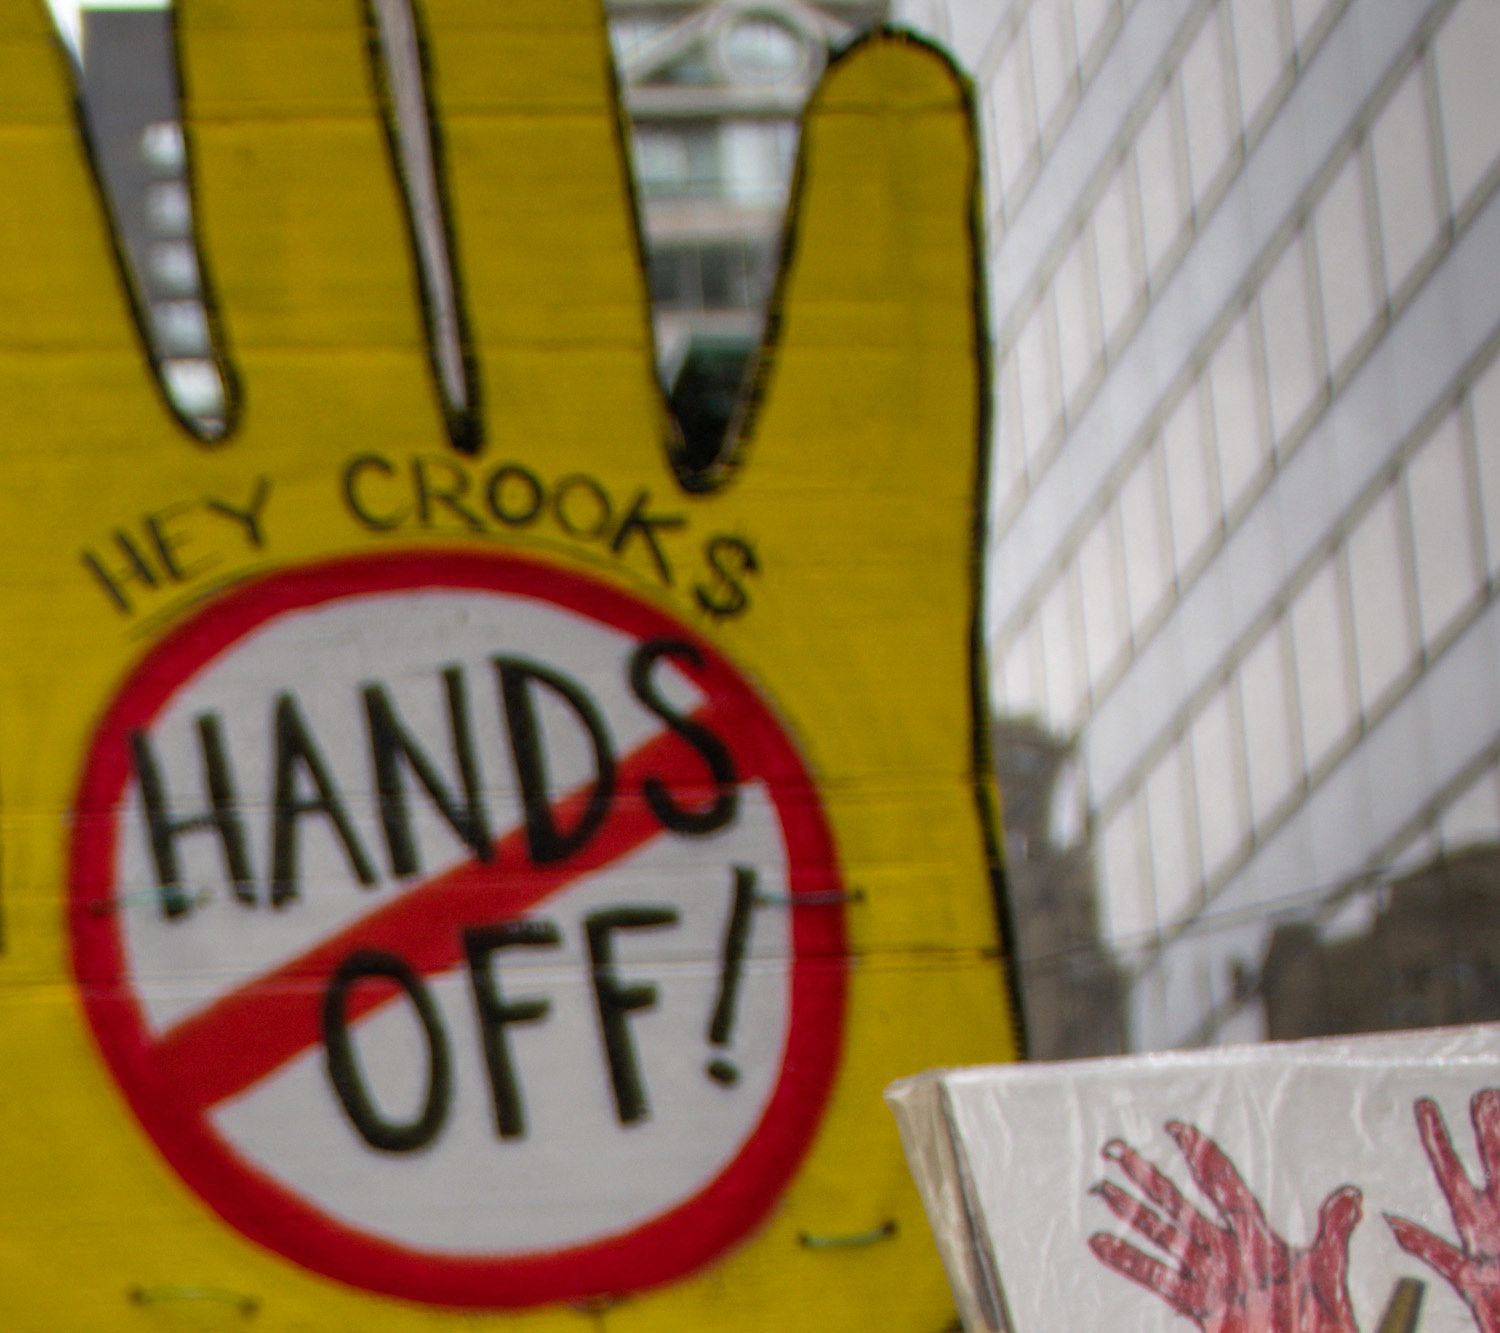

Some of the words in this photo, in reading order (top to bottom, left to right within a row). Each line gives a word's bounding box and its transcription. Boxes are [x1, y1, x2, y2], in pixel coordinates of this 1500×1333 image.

[79, 477, 272, 615] HEY
[343, 454, 764, 627] CROOKS
[130, 635, 741, 918] HANDS
[321, 866, 757, 1155] OFF!
